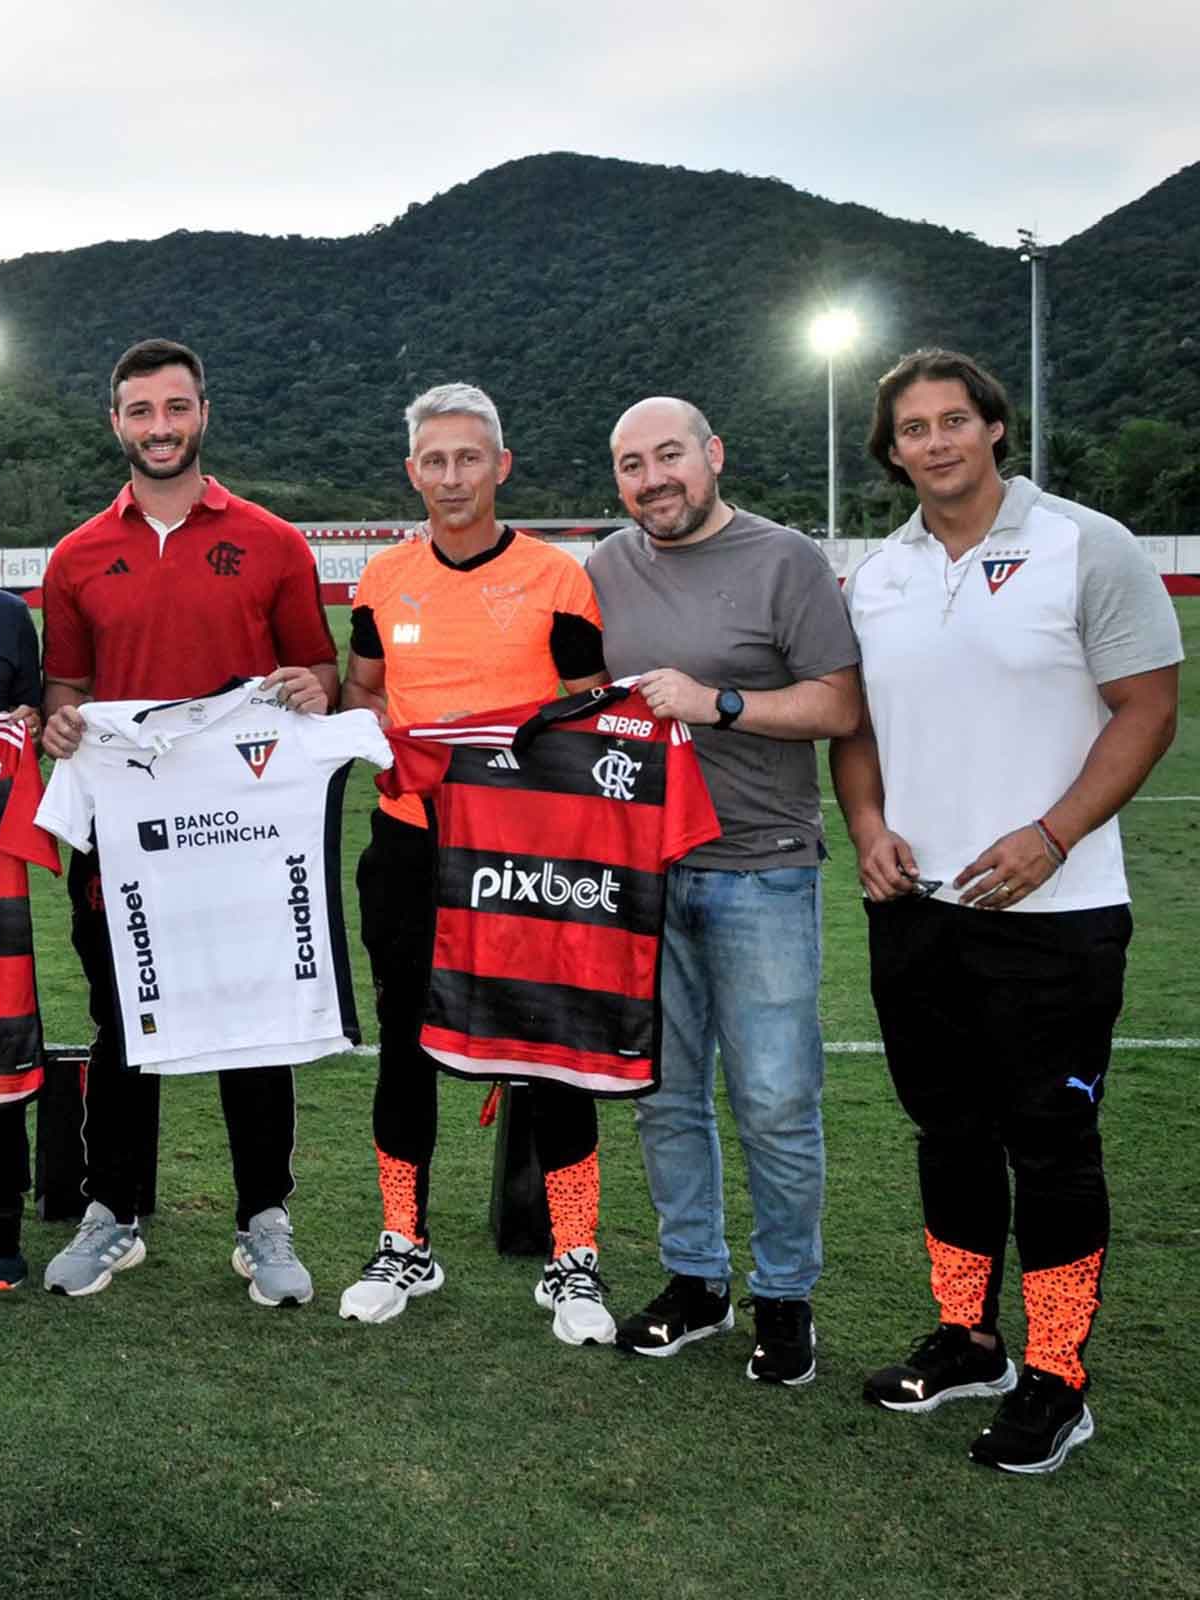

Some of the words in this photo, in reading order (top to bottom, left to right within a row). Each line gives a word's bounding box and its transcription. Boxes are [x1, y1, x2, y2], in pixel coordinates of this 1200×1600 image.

[615, 716, 654, 737] BRB
[248, 745, 266, 766] U
[173, 810, 239, 830] BANCO
[176, 823, 280, 849] PICHINCHA
[470, 860, 621, 913] pixbet
[285, 853, 317, 982] Ecuabet
[120, 880, 160, 1003] Ecuabet
